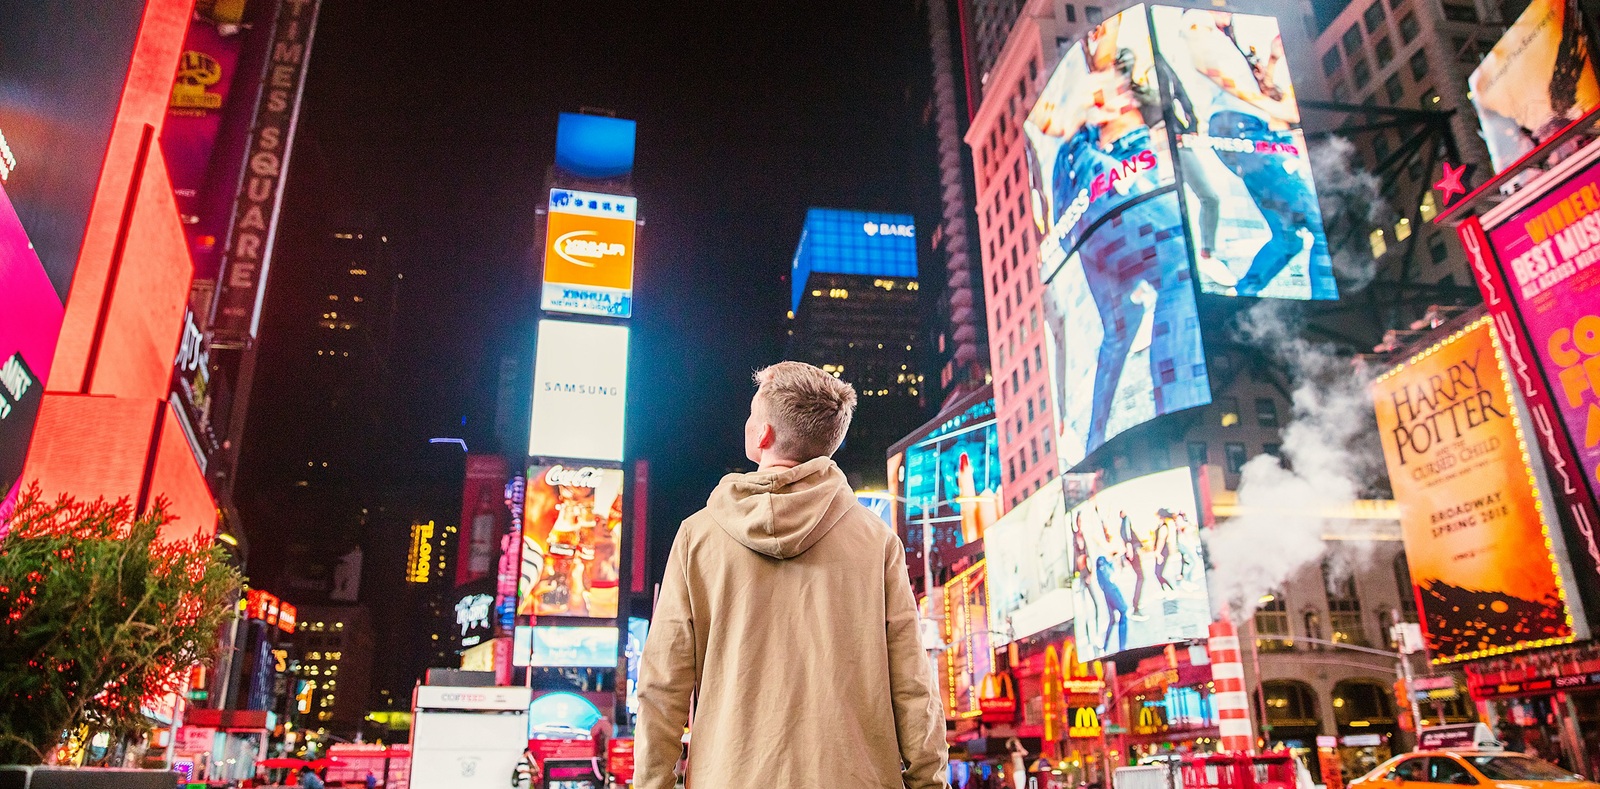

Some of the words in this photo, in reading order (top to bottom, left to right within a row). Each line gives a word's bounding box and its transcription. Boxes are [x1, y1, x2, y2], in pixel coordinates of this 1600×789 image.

[1090, 150, 1157, 203] JEANS
[230, 127, 281, 287] SQUARE
[880, 223, 915, 237] BARC
[1510, 239, 1558, 286] BEST
[544, 381, 617, 396] SAMSUNG
[1390, 348, 1483, 427] HARRY
[1392, 389, 1506, 466] POTTER
[1460, 434, 1500, 463] CHILD
[1430, 492, 1502, 524] BROADWAY
[1431, 513, 1477, 538] SPRING
[415, 520, 434, 583] NOVOTEL
[1556, 675, 1587, 688] SONY
